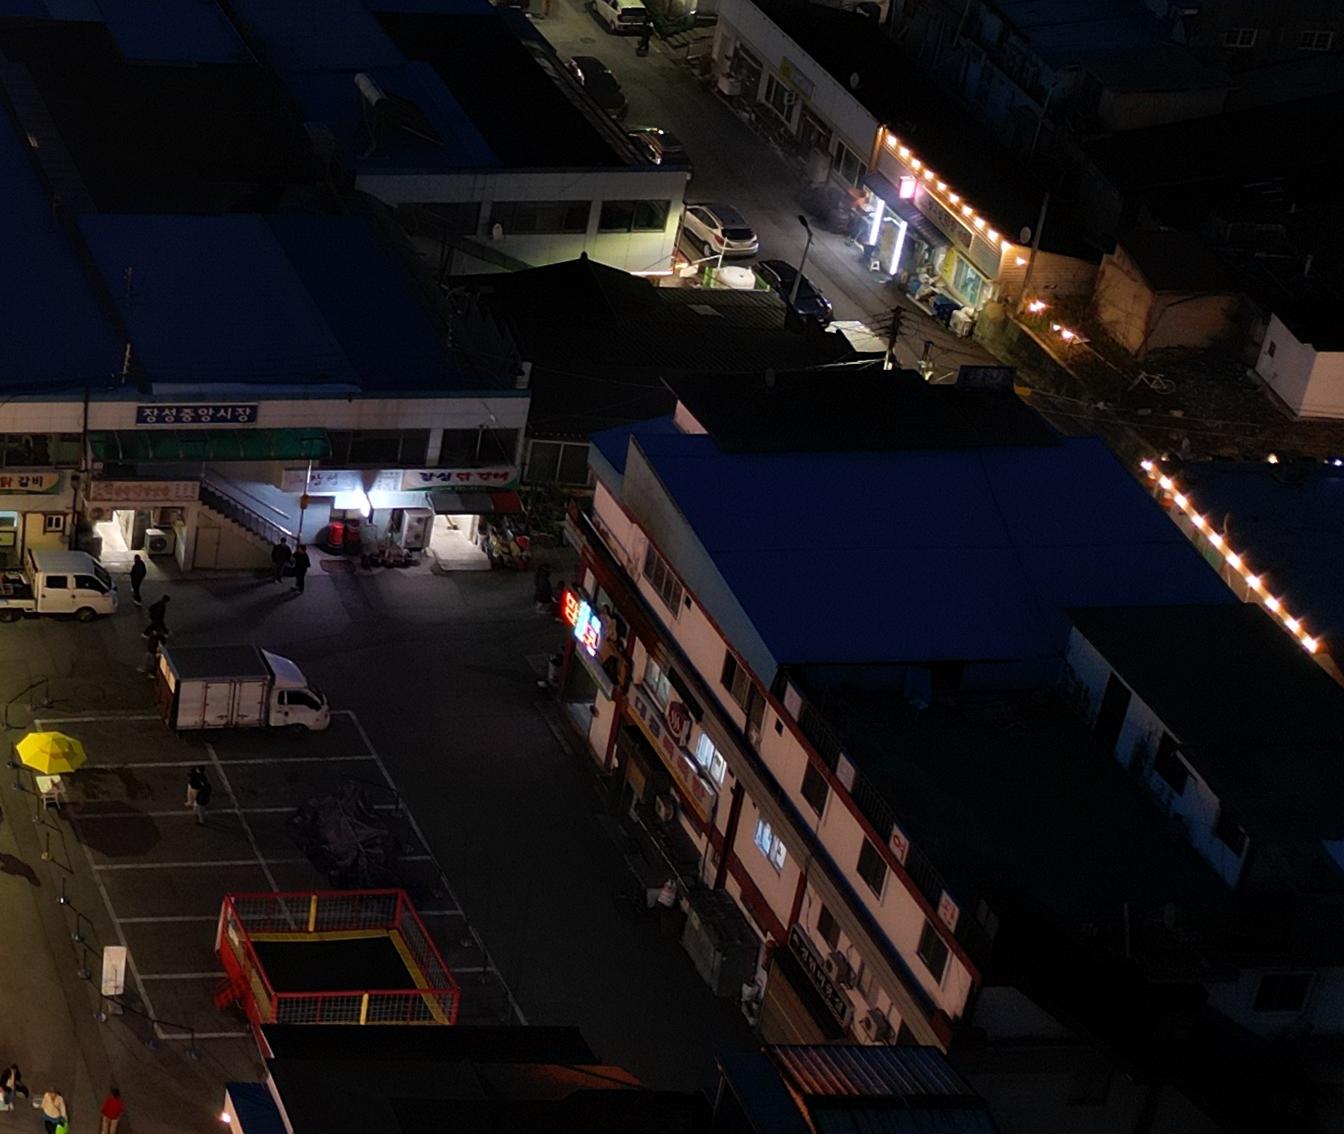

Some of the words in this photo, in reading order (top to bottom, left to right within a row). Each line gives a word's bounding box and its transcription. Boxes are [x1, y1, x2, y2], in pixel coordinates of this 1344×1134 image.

[143, 407, 252, 423] 장성중앙시장
[0, 475, 14, 488] 닭
[17, 475, 44, 488] 갈비
